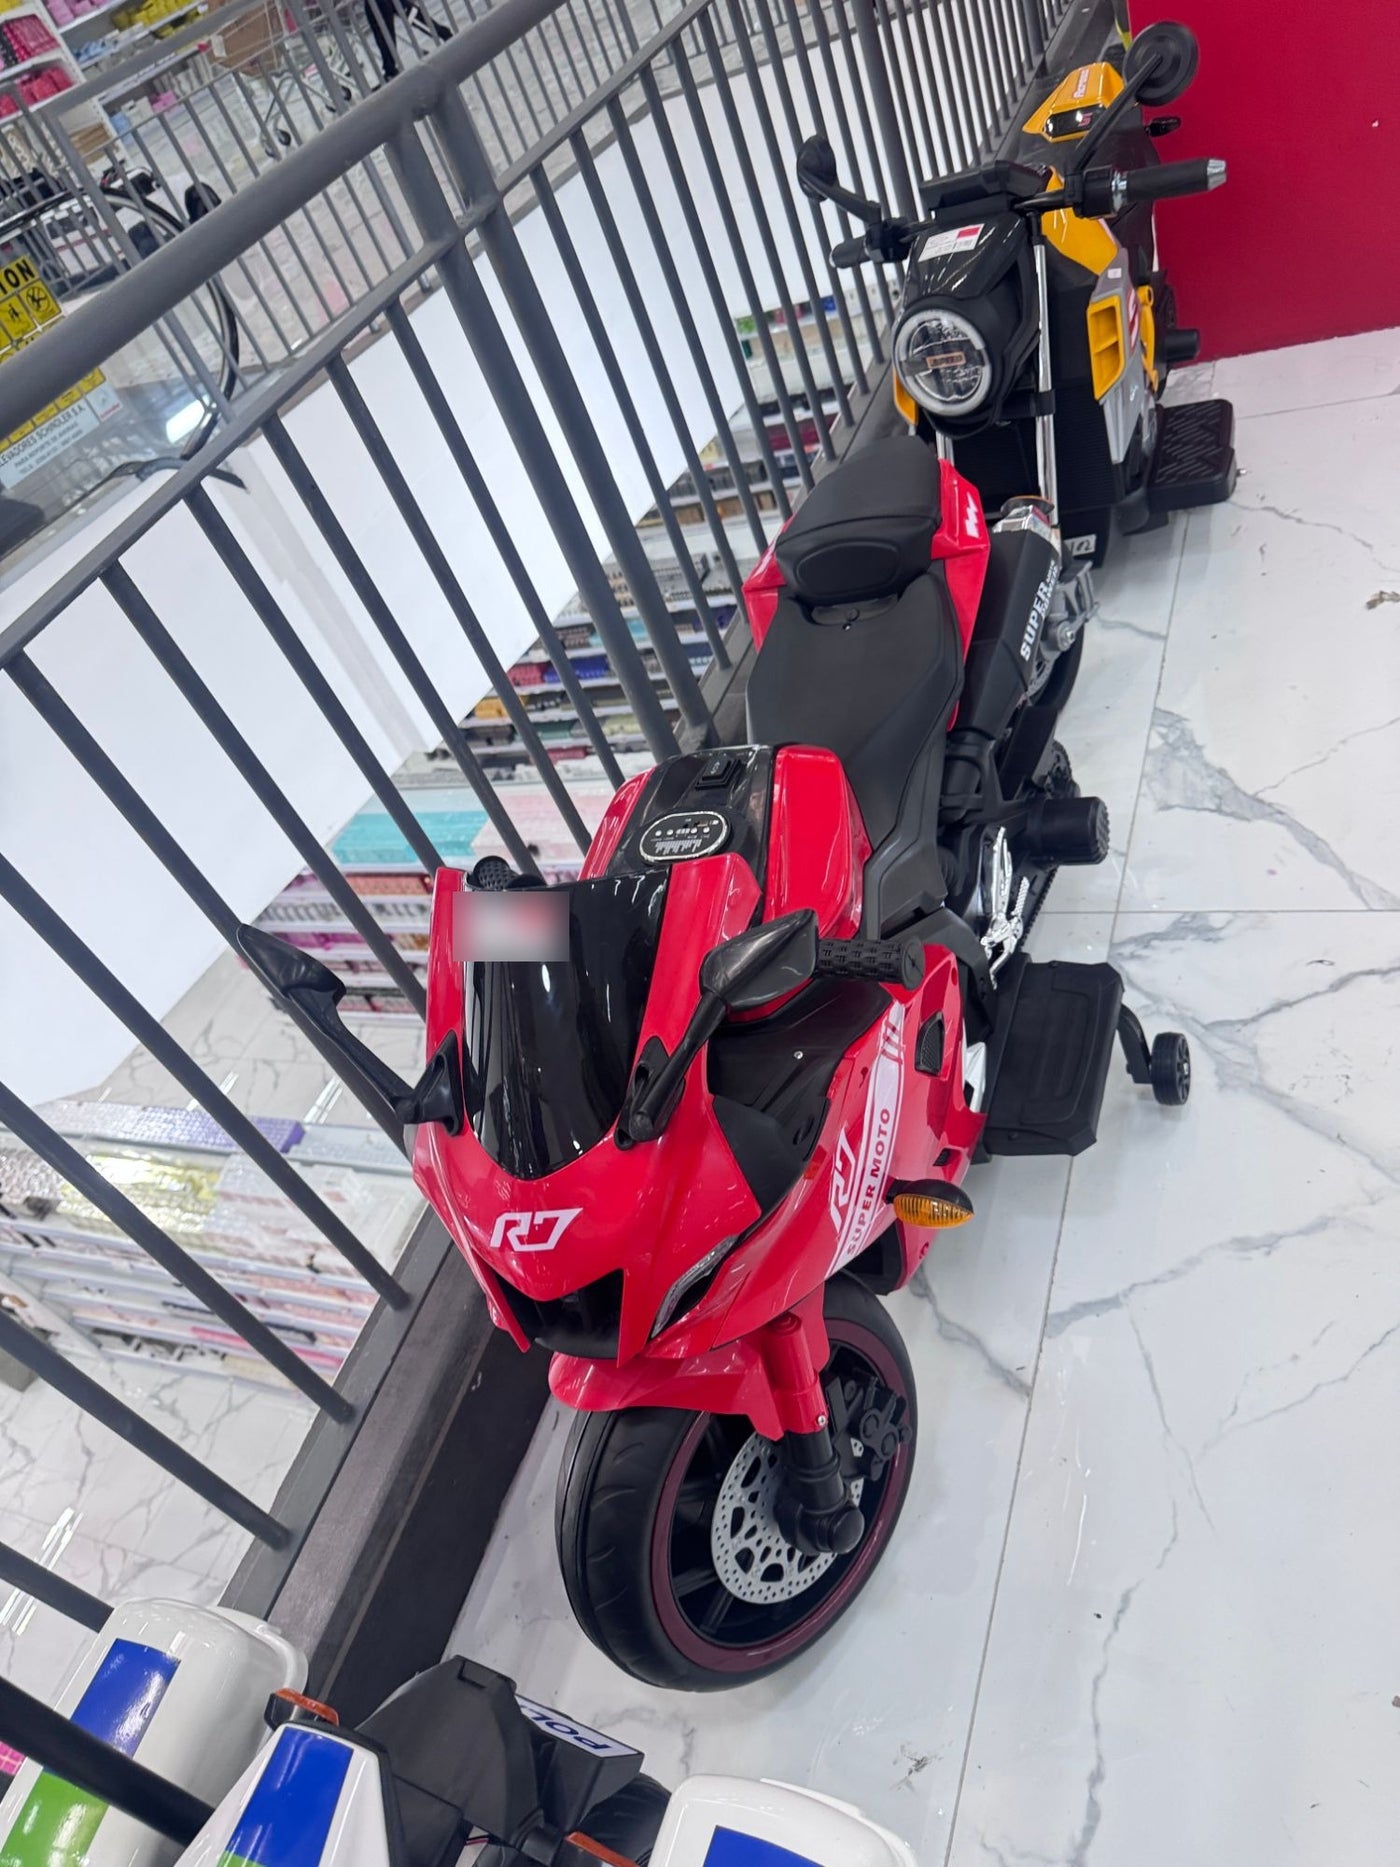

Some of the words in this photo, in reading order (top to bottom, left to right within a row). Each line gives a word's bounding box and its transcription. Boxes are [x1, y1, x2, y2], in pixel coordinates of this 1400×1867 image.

[1020, 581, 1049, 661] SUPER
[830, 1121, 856, 1235] R7
[847, 1184, 876, 1255] SUPER
[870, 1108, 891, 1178] MOTO
[489, 1207, 584, 1253] R7
